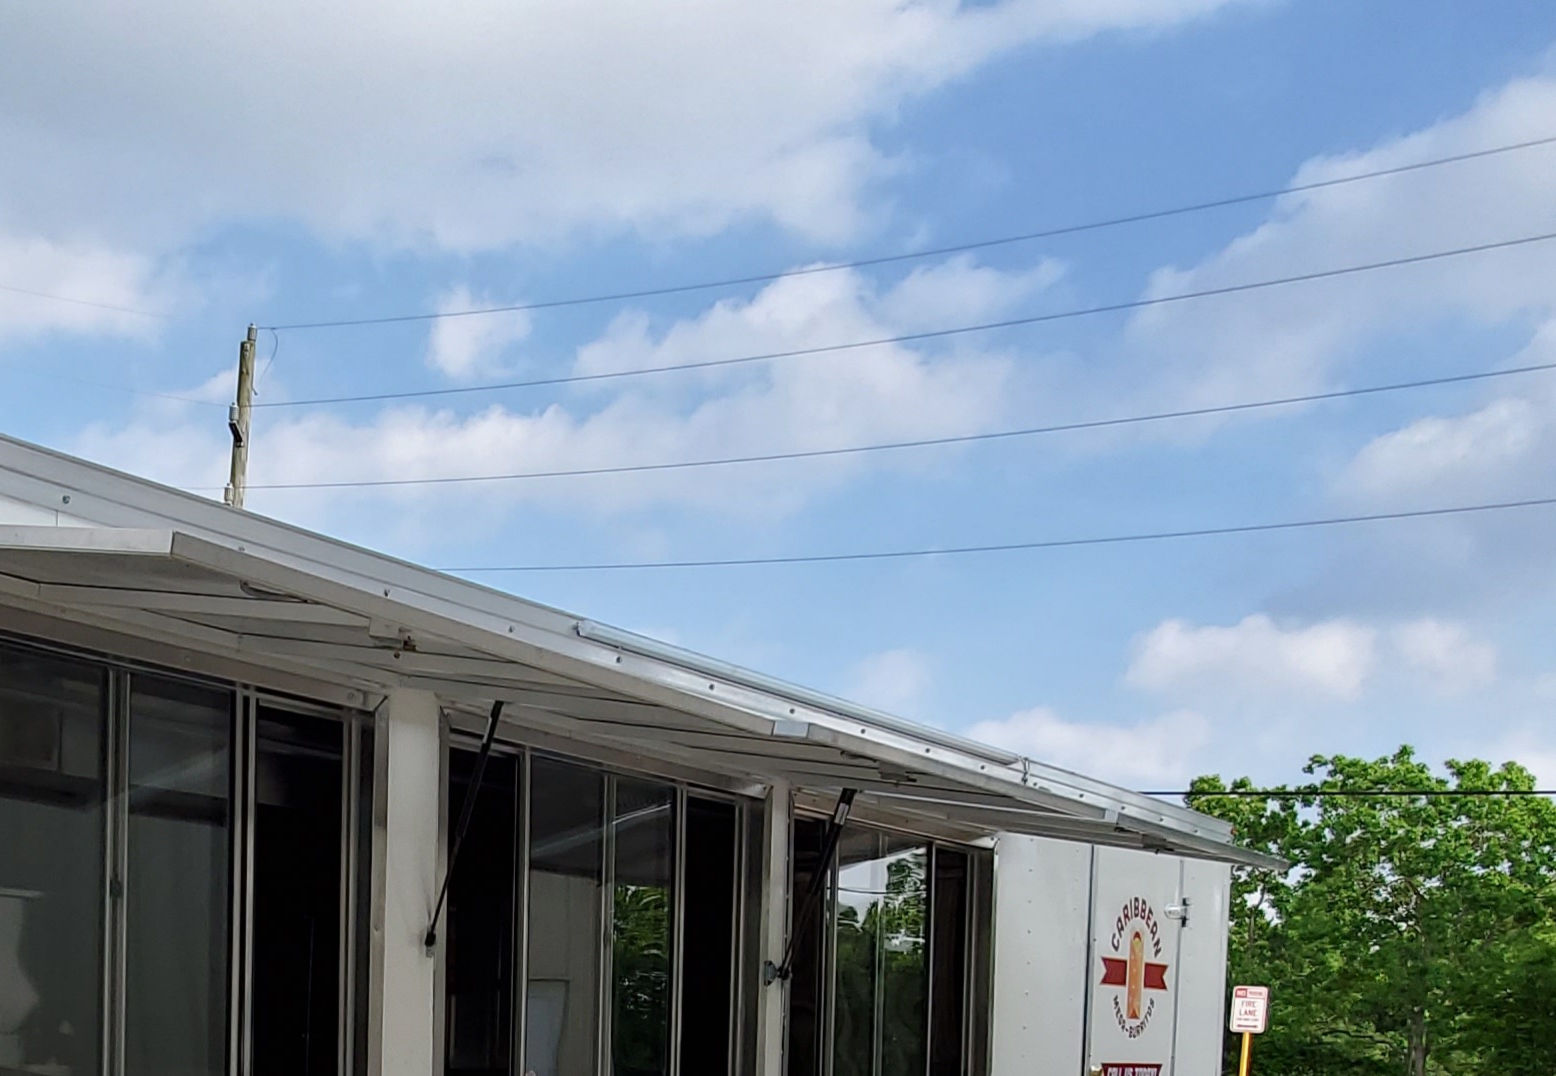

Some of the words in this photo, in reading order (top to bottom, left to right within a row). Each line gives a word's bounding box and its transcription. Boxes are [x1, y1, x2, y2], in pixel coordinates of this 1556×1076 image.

[1111, 896, 1162, 958] CARIBBEAN
[1241, 1000, 1257, 1008] FIRE
[1239, 1008, 1258, 1017] LANE
